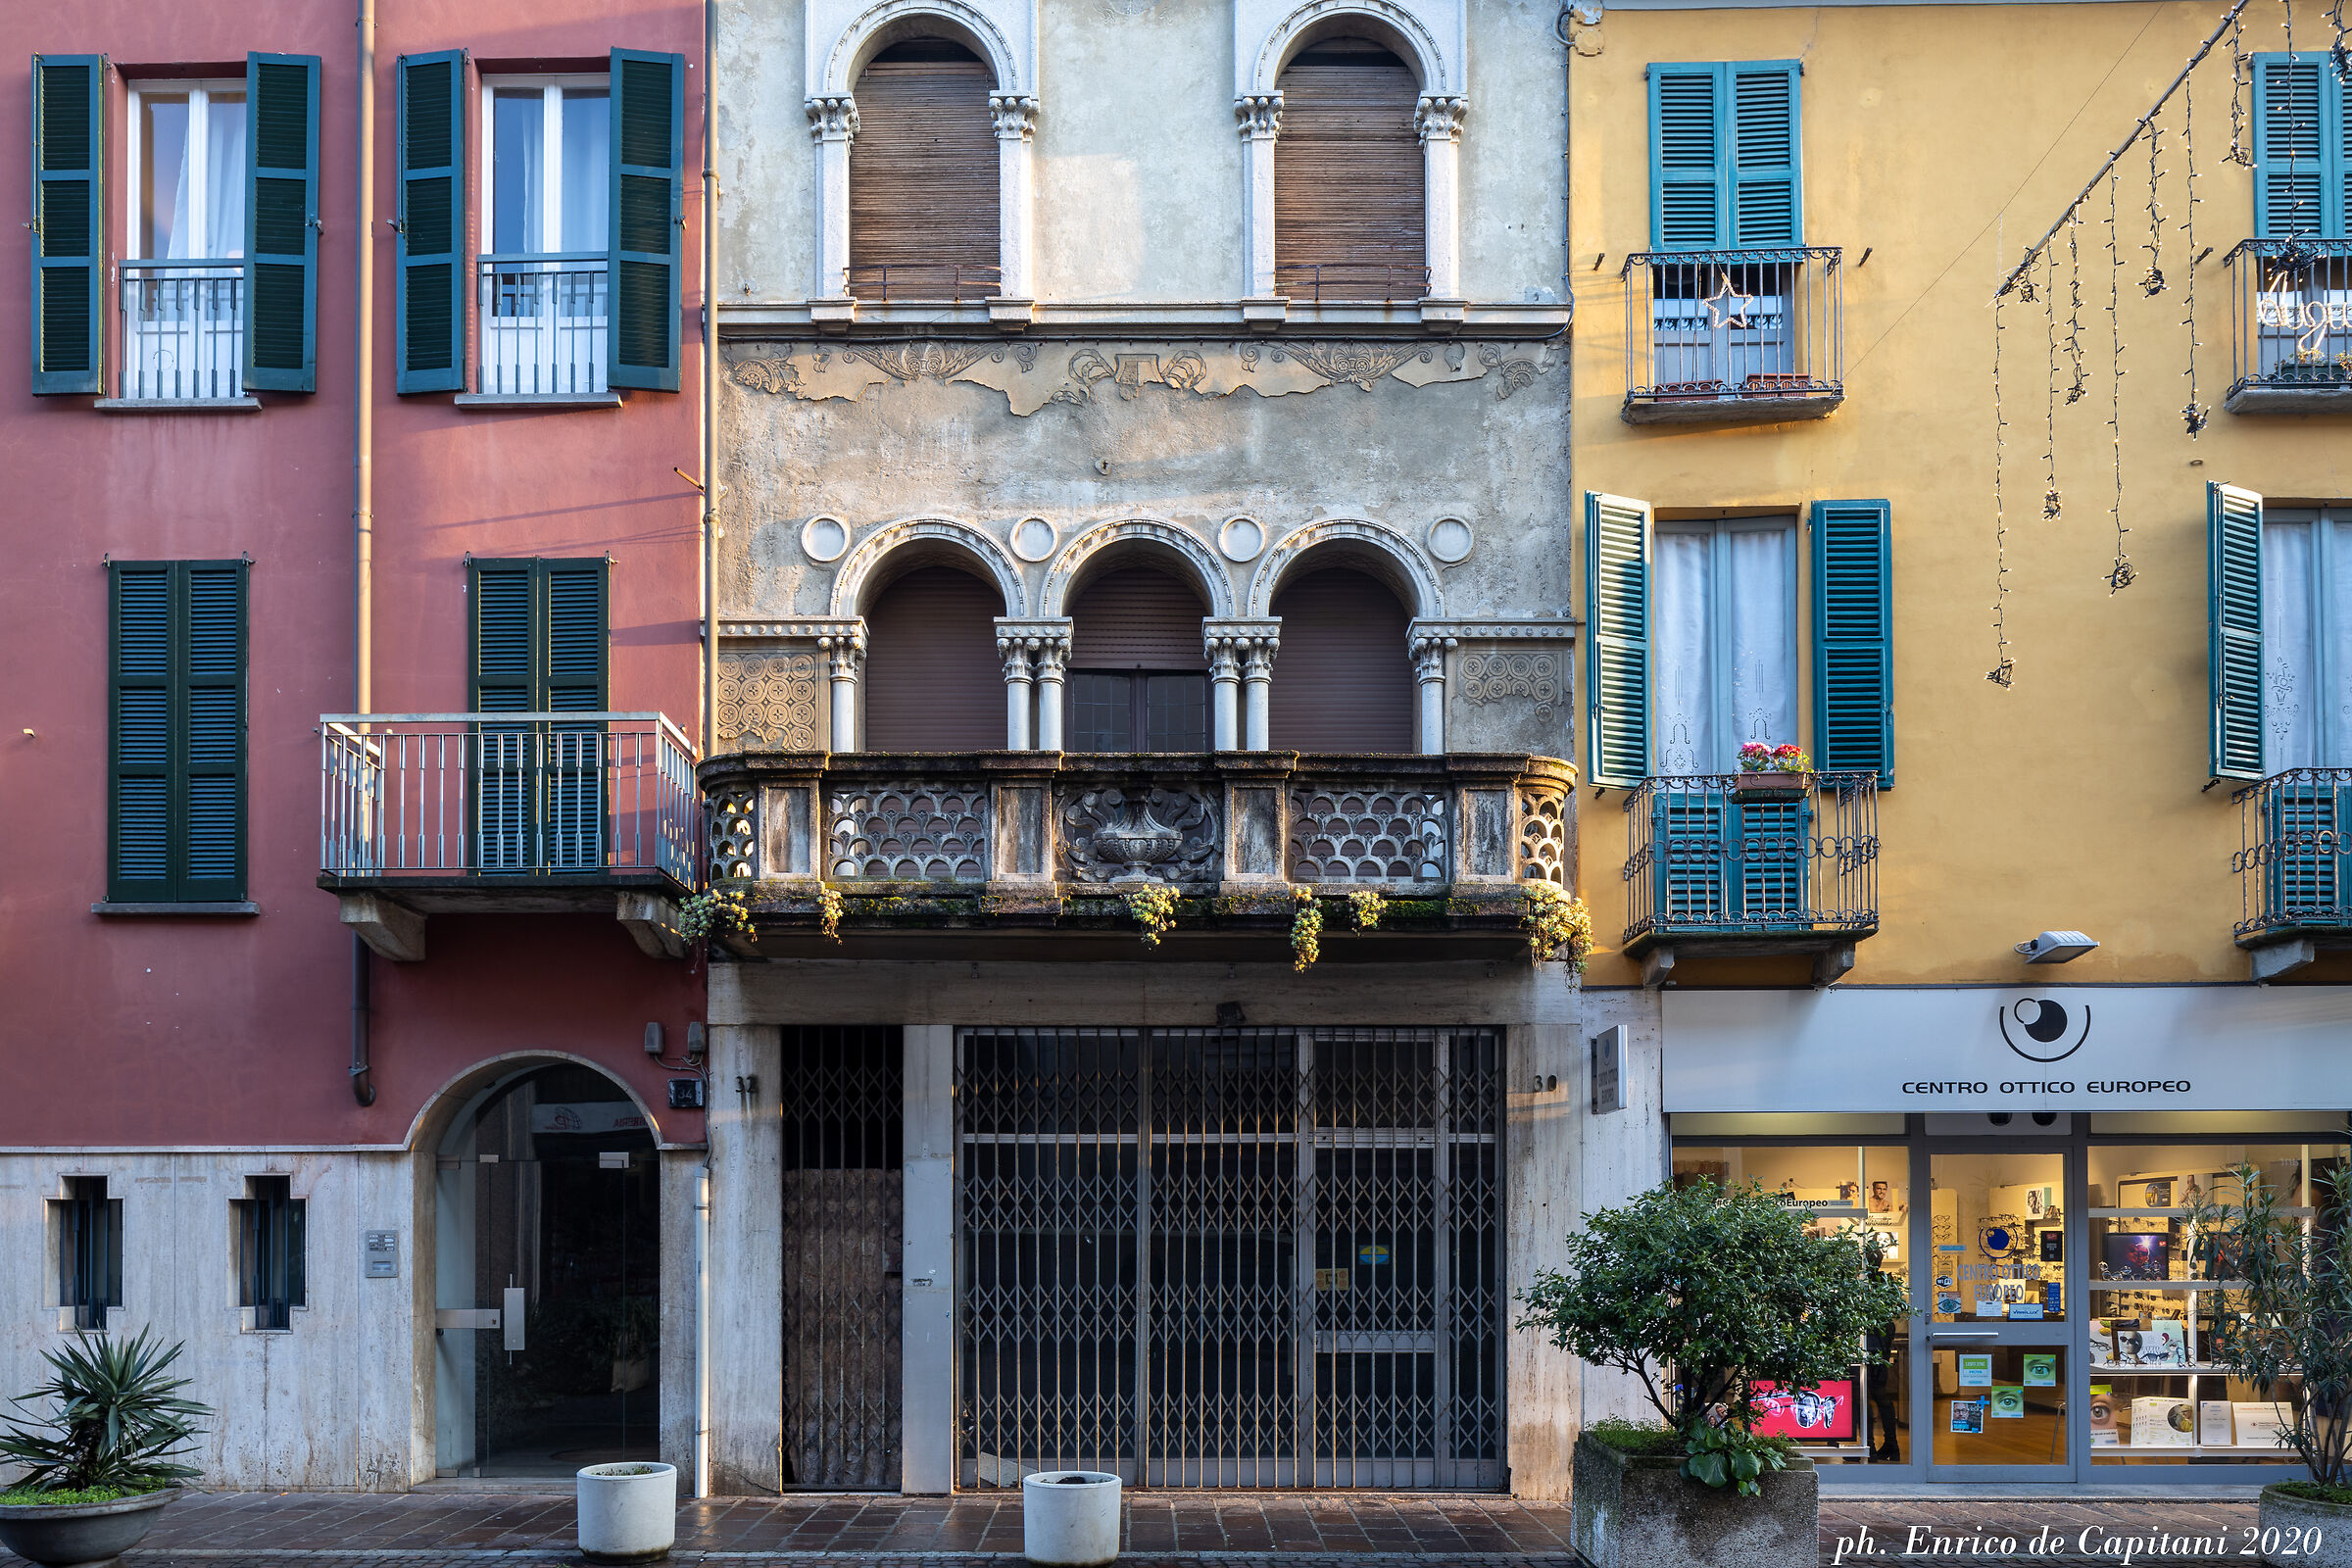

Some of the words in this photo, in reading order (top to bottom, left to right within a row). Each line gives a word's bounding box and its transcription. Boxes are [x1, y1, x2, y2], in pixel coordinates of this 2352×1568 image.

[735, 1075, 760, 1094] 32
[1533, 1074, 1557, 1093] 30
[1901, 1081, 1988, 1095] CENTRO
[1999, 1081, 2076, 1095] OTTICO
[2086, 1080, 2191, 1094] EUROPEO
[677, 1088, 692, 1100] 34
[1956, 1263, 1998, 1281] CENTRO
[2002, 1263, 2040, 1280] OTTICO
[1974, 1284, 2024, 1301] EUROPEO
